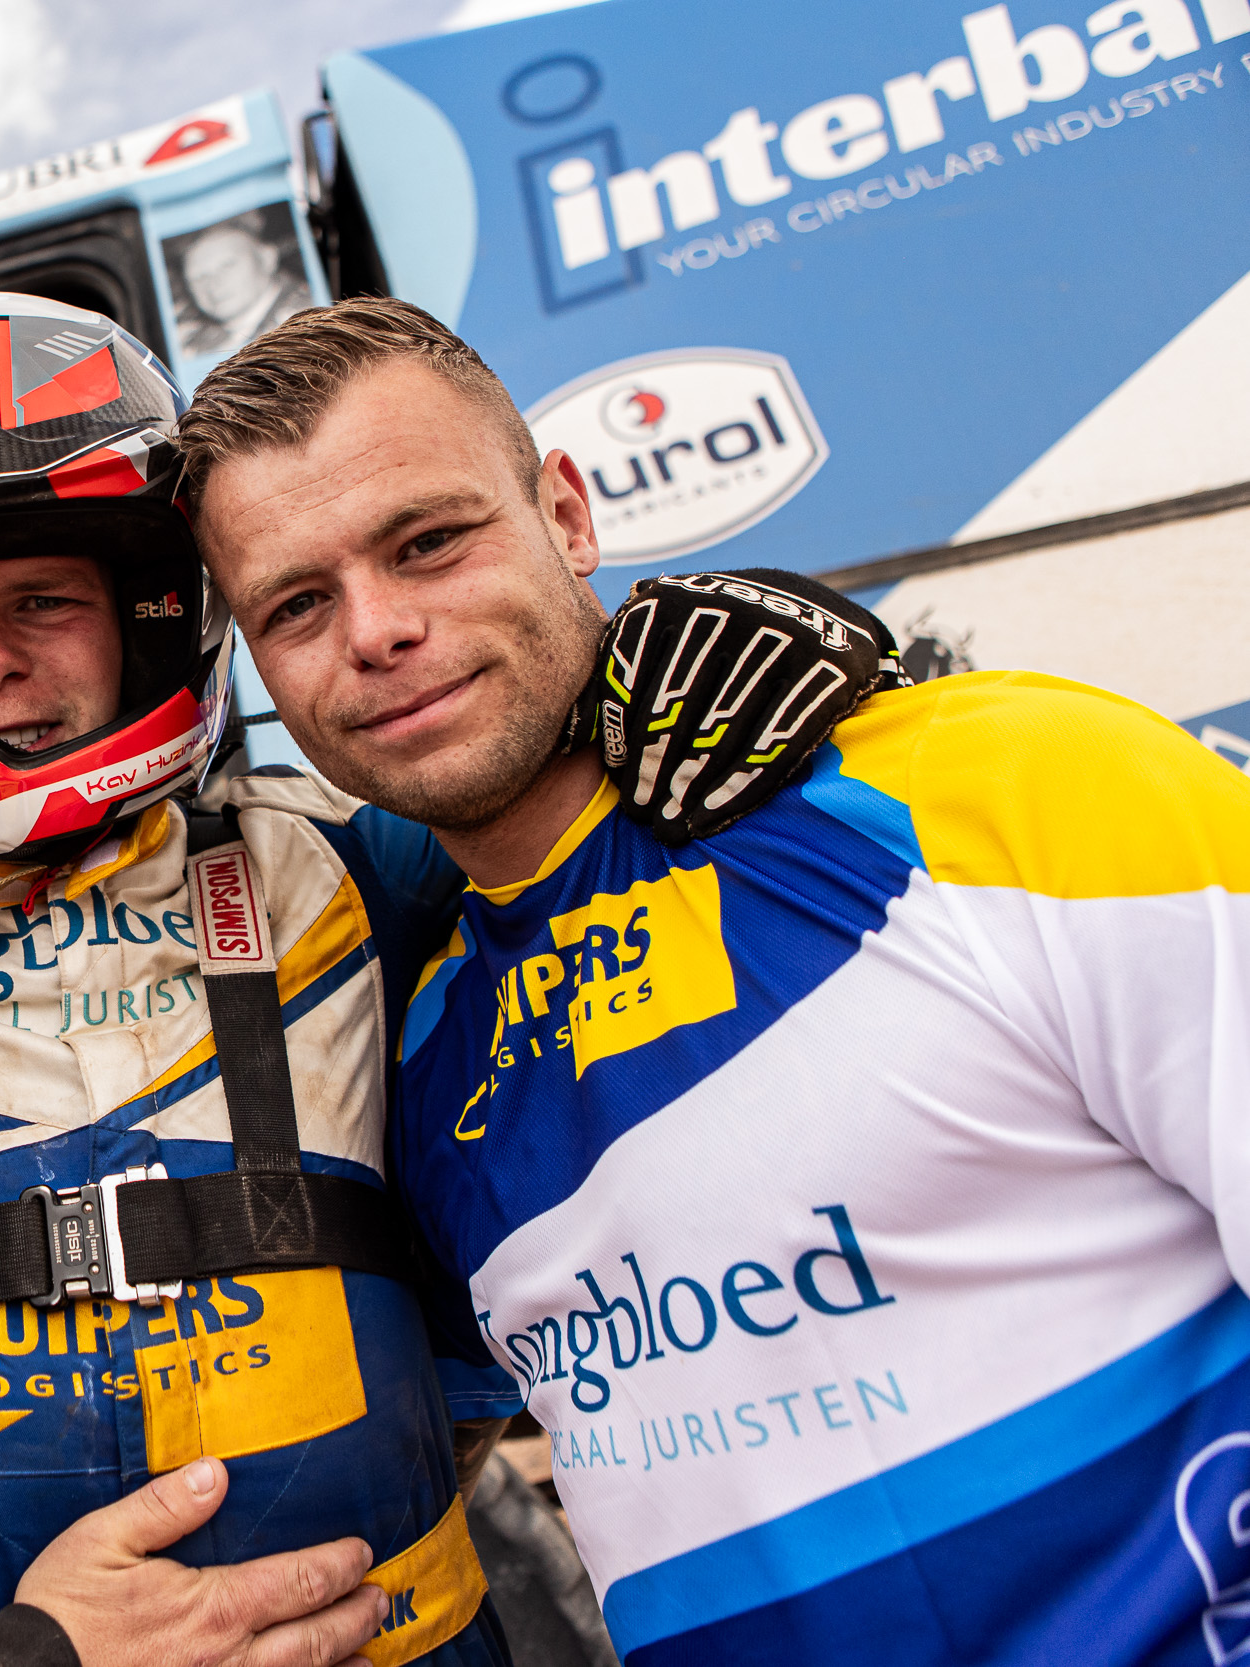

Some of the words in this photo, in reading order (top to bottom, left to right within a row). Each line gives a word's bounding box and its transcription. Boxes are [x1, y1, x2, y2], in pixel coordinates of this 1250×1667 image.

[656, 217, 781, 276] YOUR
[787, 141, 1004, 233] CIRCULAR
[1012, 62, 1224, 157] INDUSTRY
[591, 397, 785, 500] urol
[135, 593, 183, 619] stilo
[86, 769, 137, 796] Kay
[146, 733, 201, 774] Huzink
[206, 860, 251, 954] SIMPSON
[60, 971, 199, 1033] JURIST
[642, 1368, 909, 1472] JURISTEN
